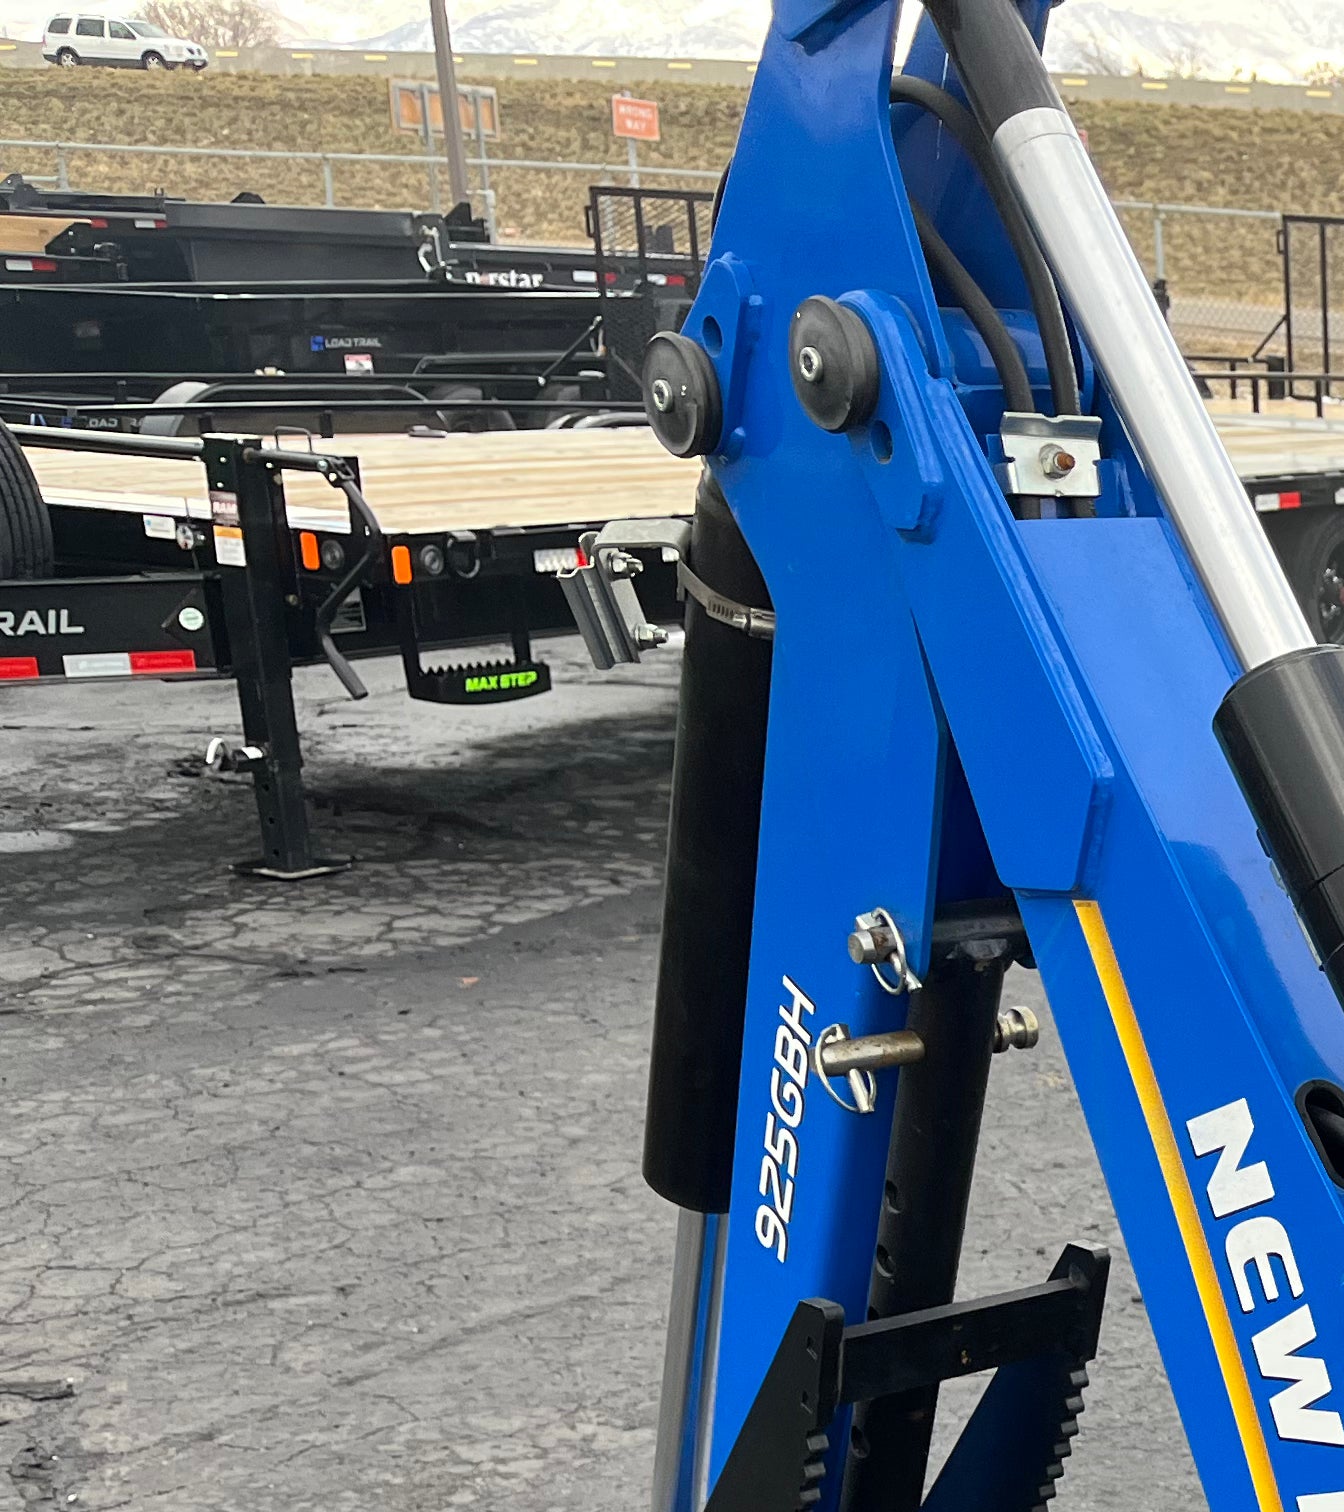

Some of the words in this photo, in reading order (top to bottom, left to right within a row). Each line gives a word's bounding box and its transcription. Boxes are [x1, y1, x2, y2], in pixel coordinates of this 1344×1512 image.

[465, 675, 498, 693] MAX
[499, 670, 538, 689] STEP
[755, 975, 817, 1264] 925GBH
